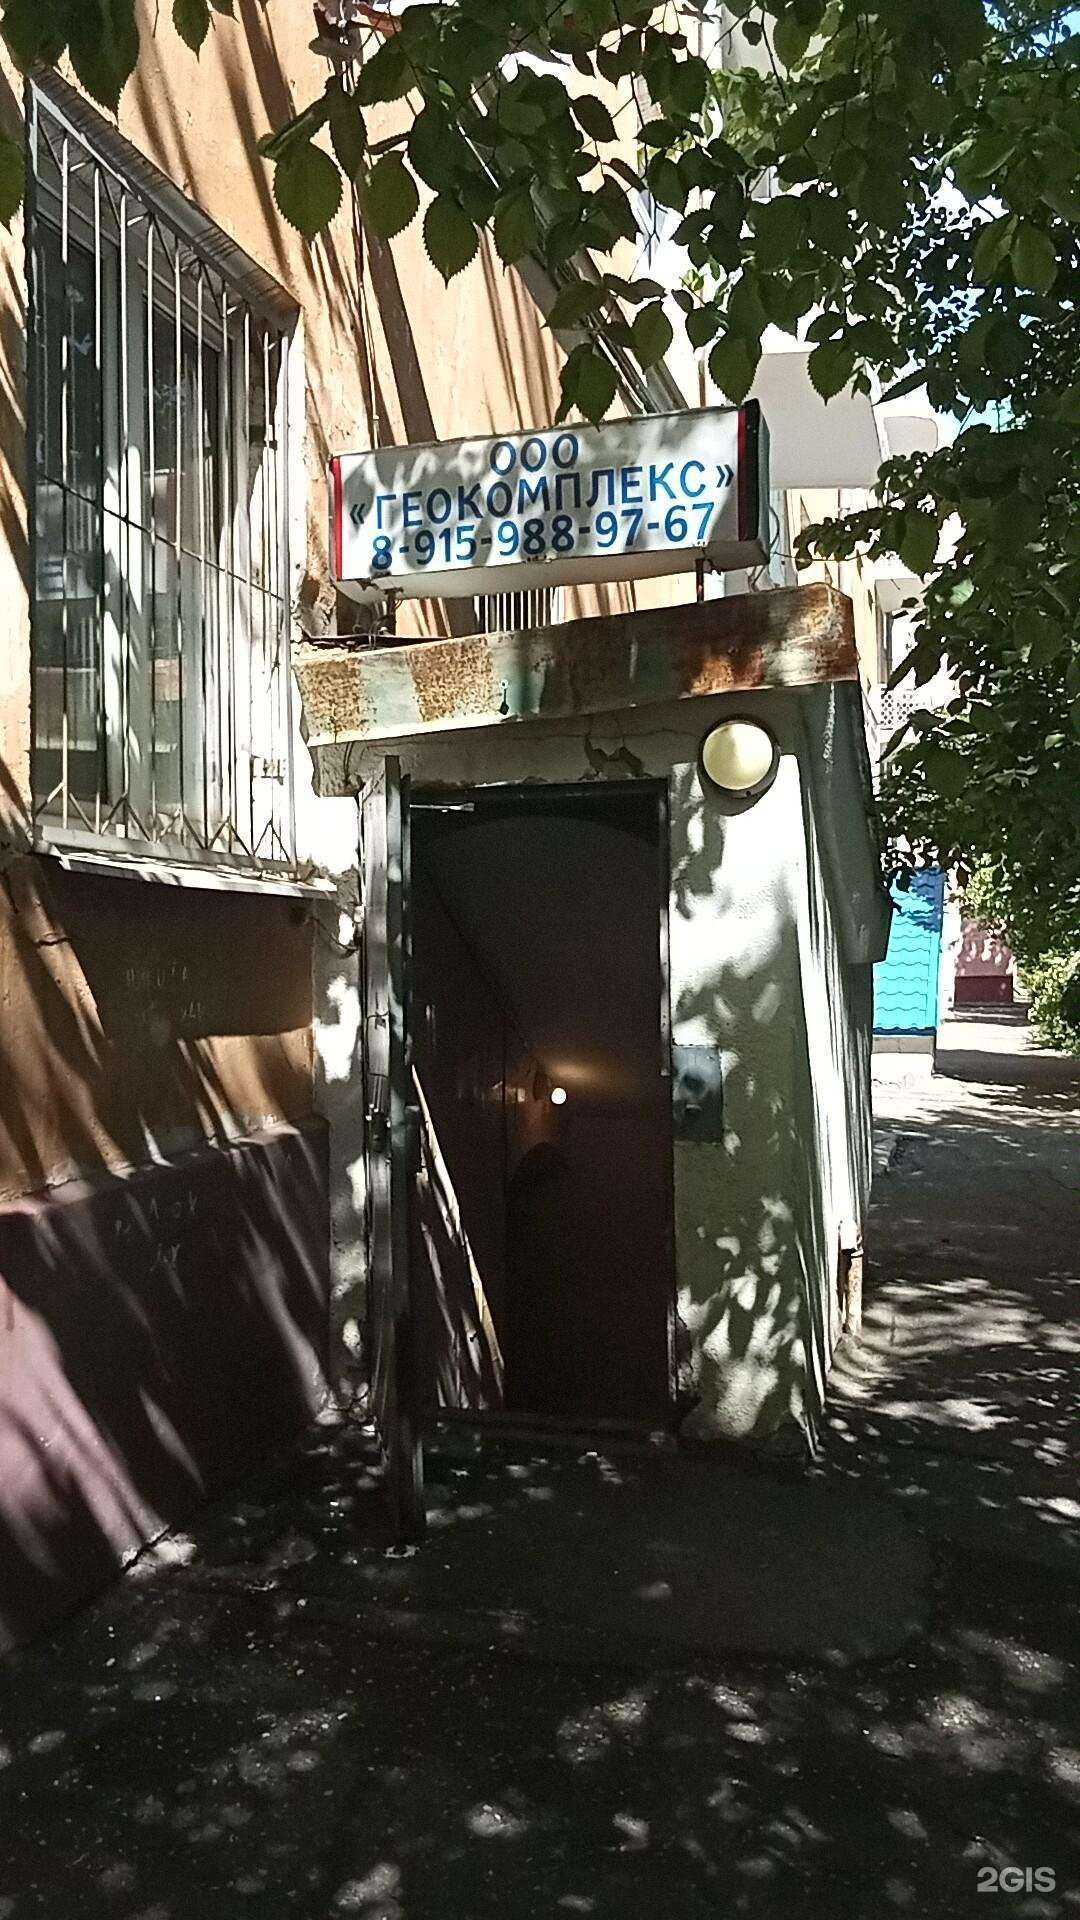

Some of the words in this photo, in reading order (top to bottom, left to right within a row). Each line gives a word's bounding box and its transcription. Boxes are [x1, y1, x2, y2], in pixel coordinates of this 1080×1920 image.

[489, 433, 579, 476] ООО
[349, 460, 734, 529] «ГЕОКОМПЛЕКС»
[371, 502, 715, 570] 8-915-988-97-67
